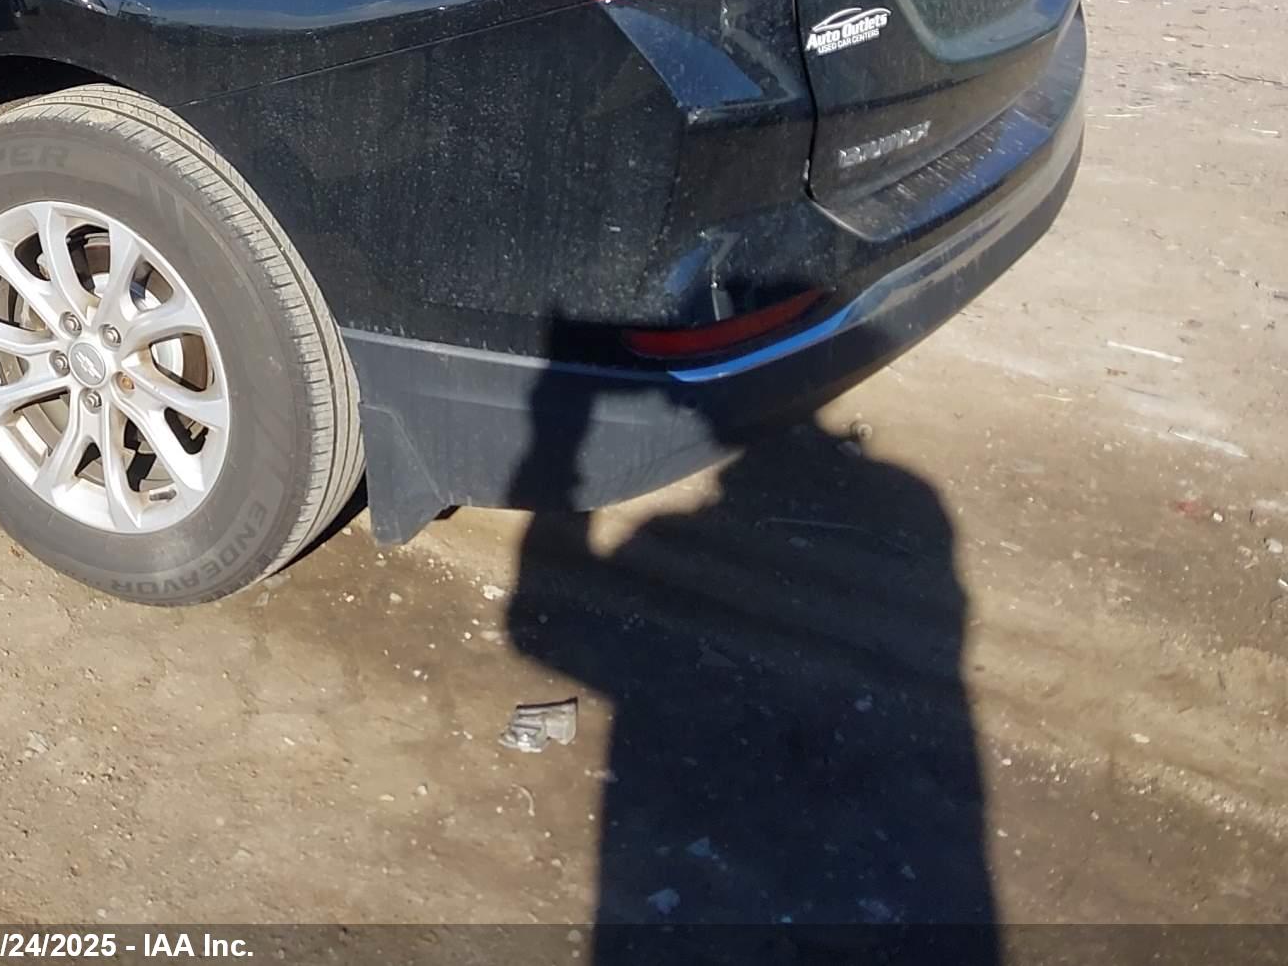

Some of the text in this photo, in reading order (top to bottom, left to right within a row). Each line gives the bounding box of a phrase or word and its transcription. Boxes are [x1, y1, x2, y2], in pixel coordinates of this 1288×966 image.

[805, 13, 888, 52] Auto Outlets
[817, 28, 880, 55] USED CAR CENTERS
[111, 499, 268, 594] ENDEAVOR
